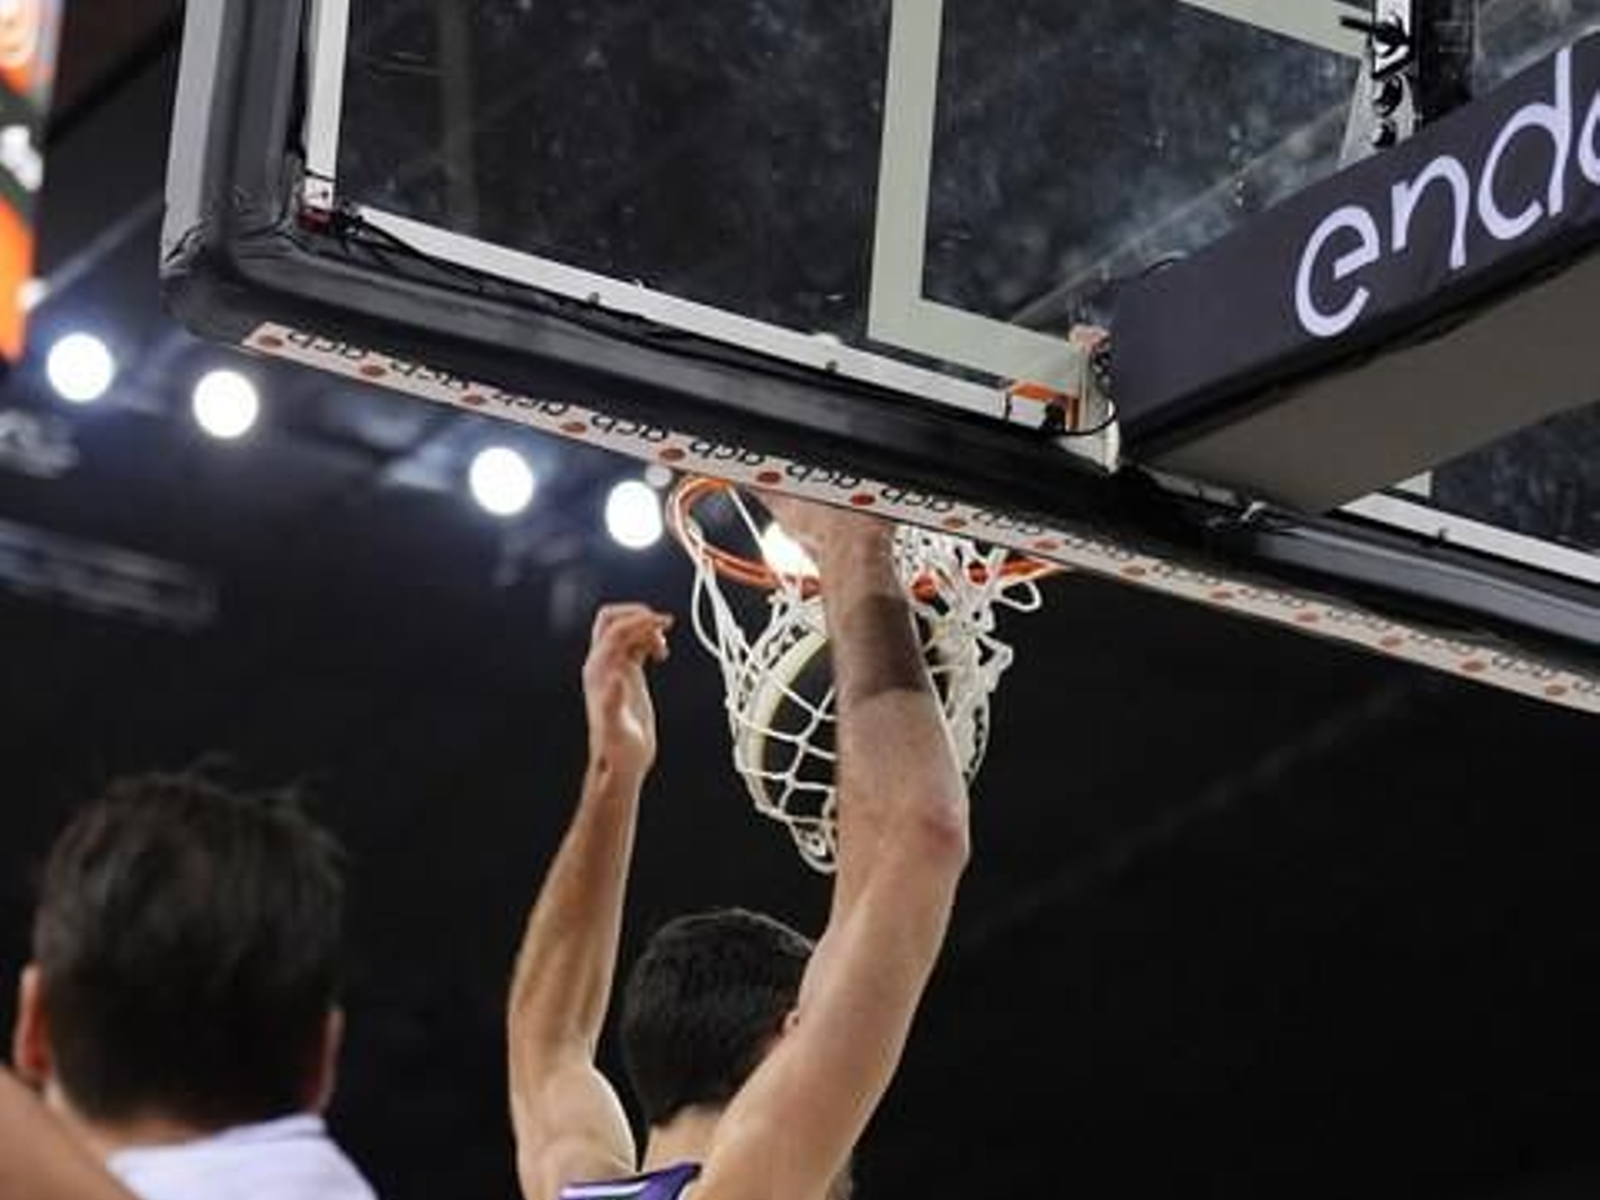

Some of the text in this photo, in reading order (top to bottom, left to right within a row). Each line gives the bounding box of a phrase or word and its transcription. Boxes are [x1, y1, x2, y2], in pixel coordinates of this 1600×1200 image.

[591, 410, 668, 441] acb
[689, 440, 764, 466] acb
[786, 464, 859, 488] acb
